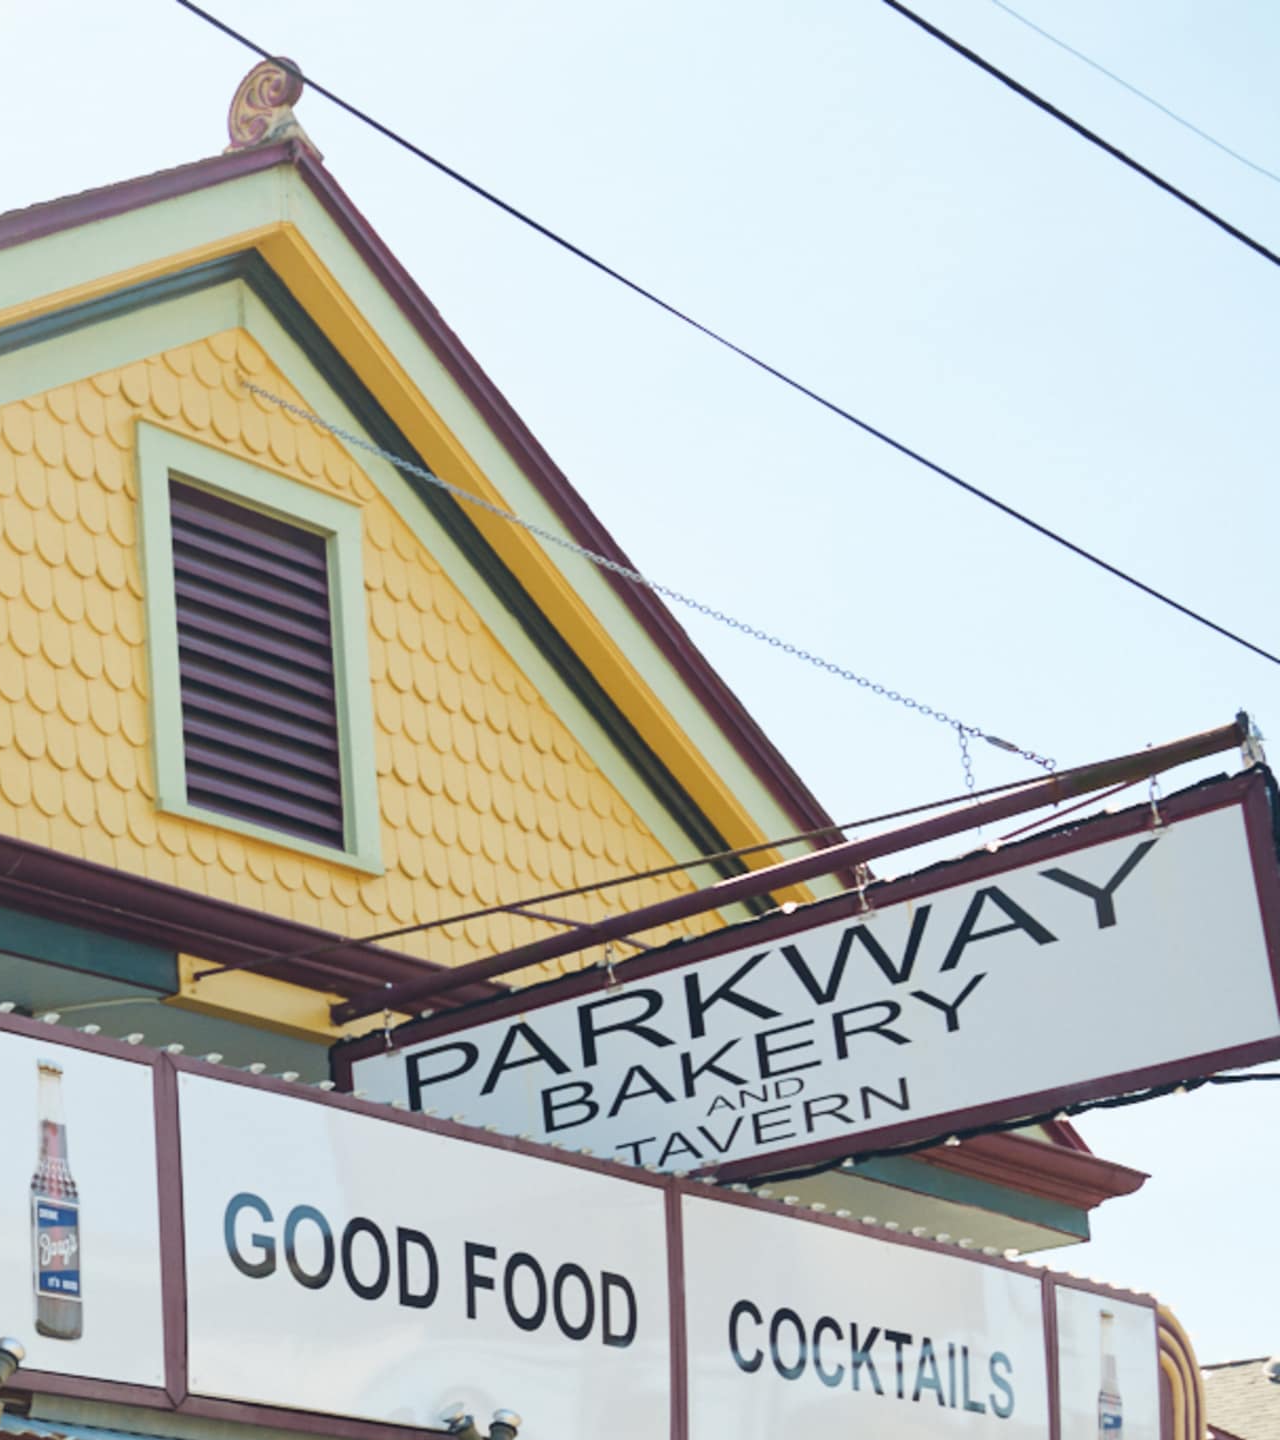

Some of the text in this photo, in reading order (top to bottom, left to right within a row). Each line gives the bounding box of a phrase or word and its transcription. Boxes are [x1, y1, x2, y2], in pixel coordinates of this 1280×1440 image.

[405, 839, 1161, 1112] PARKWAY
[540, 972, 988, 1133] BAKERY
[615, 1077, 910, 1167] TAVERN
[706, 1077, 805, 1117] AND
[223, 1191, 638, 1349] GOOD FOOD
[728, 1299, 1015, 1419] COCKTAILS
